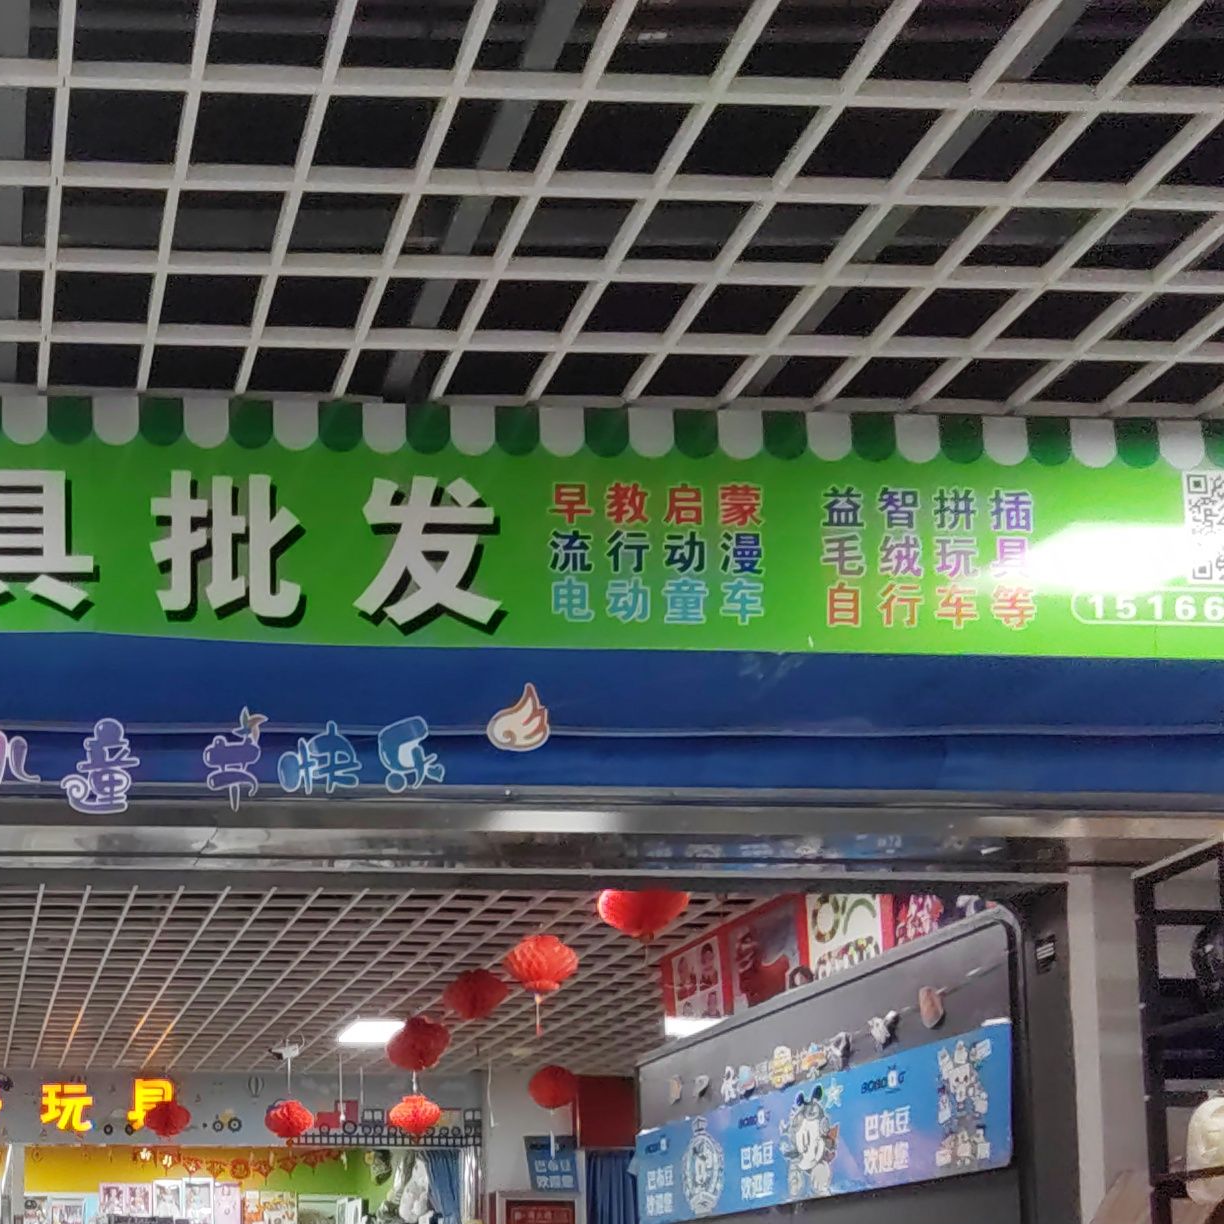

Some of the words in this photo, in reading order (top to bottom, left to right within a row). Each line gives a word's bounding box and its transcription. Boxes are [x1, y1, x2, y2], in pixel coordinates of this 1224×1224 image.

[548, 481, 765, 528] 早教启蒙
[821, 486, 1033, 534] 益智拼插
[548, 529, 765, 576] 流行动漫
[821, 534, 1034, 580] 毛绒玩具
[551, 577, 765, 626] 电动童车
[824, 582, 1040, 630] 自行车等
[863, 1105, 911, 1142] 巴布豆
[863, 1142, 910, 1176] 欢迎您
